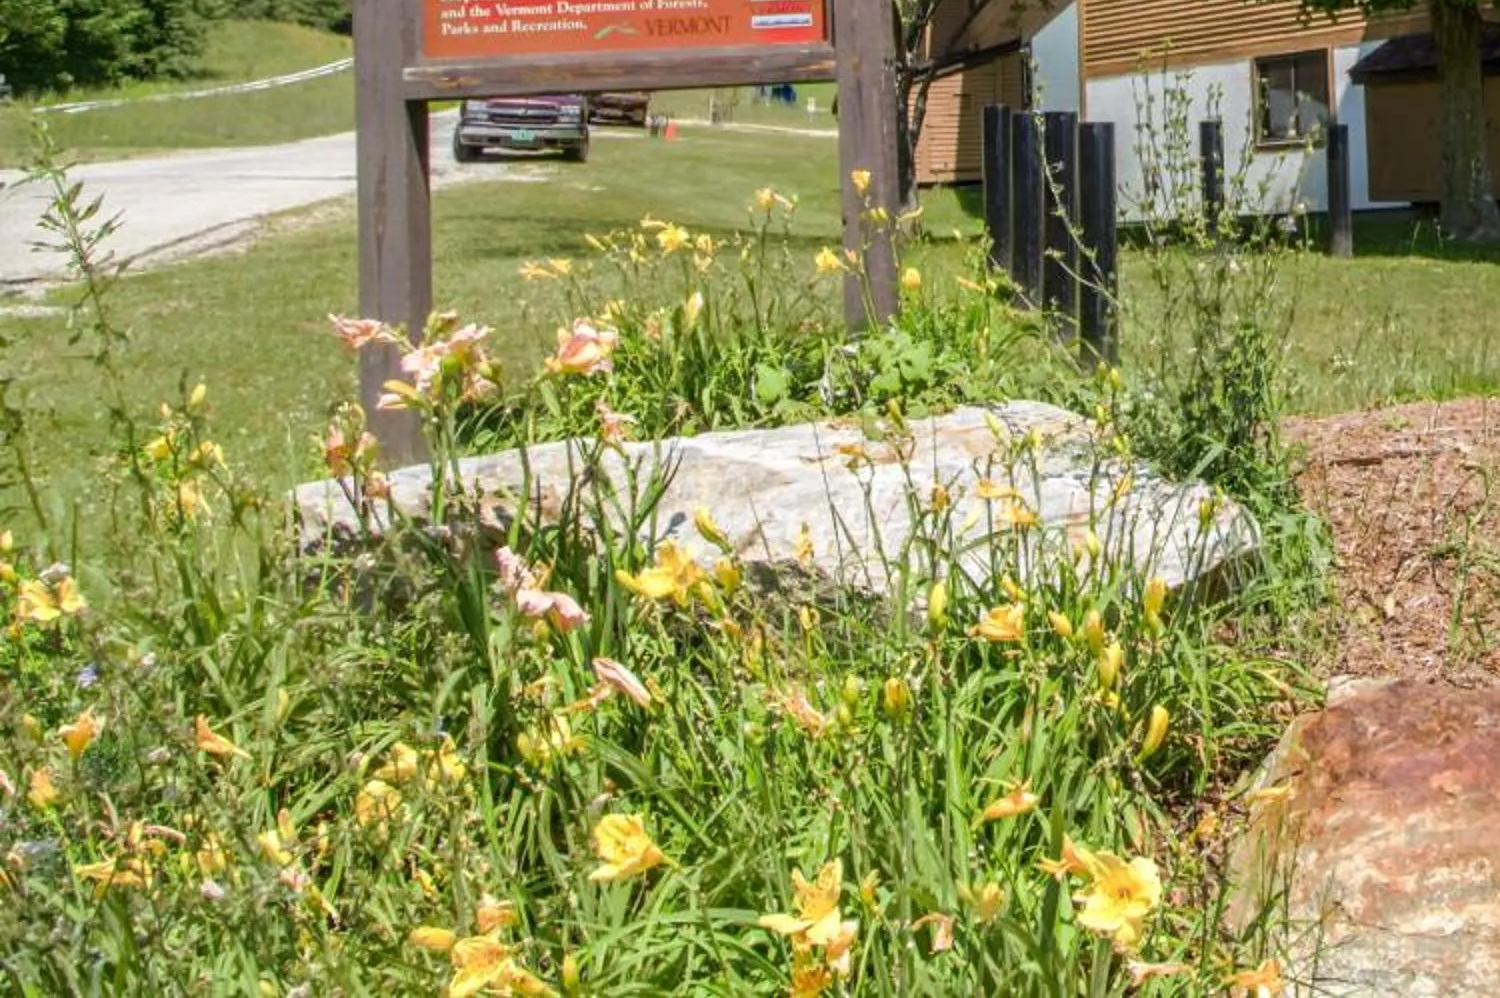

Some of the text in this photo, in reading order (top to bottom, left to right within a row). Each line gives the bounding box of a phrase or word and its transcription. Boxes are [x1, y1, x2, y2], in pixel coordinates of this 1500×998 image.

[441, 5, 465, 19] and
[469, 3, 491, 17] the
[496, 2, 553, 16] Vermont
[441, 20, 479, 36] Parks
[483, 19, 507, 33] and
[645, 16, 732, 36] VERMONT
